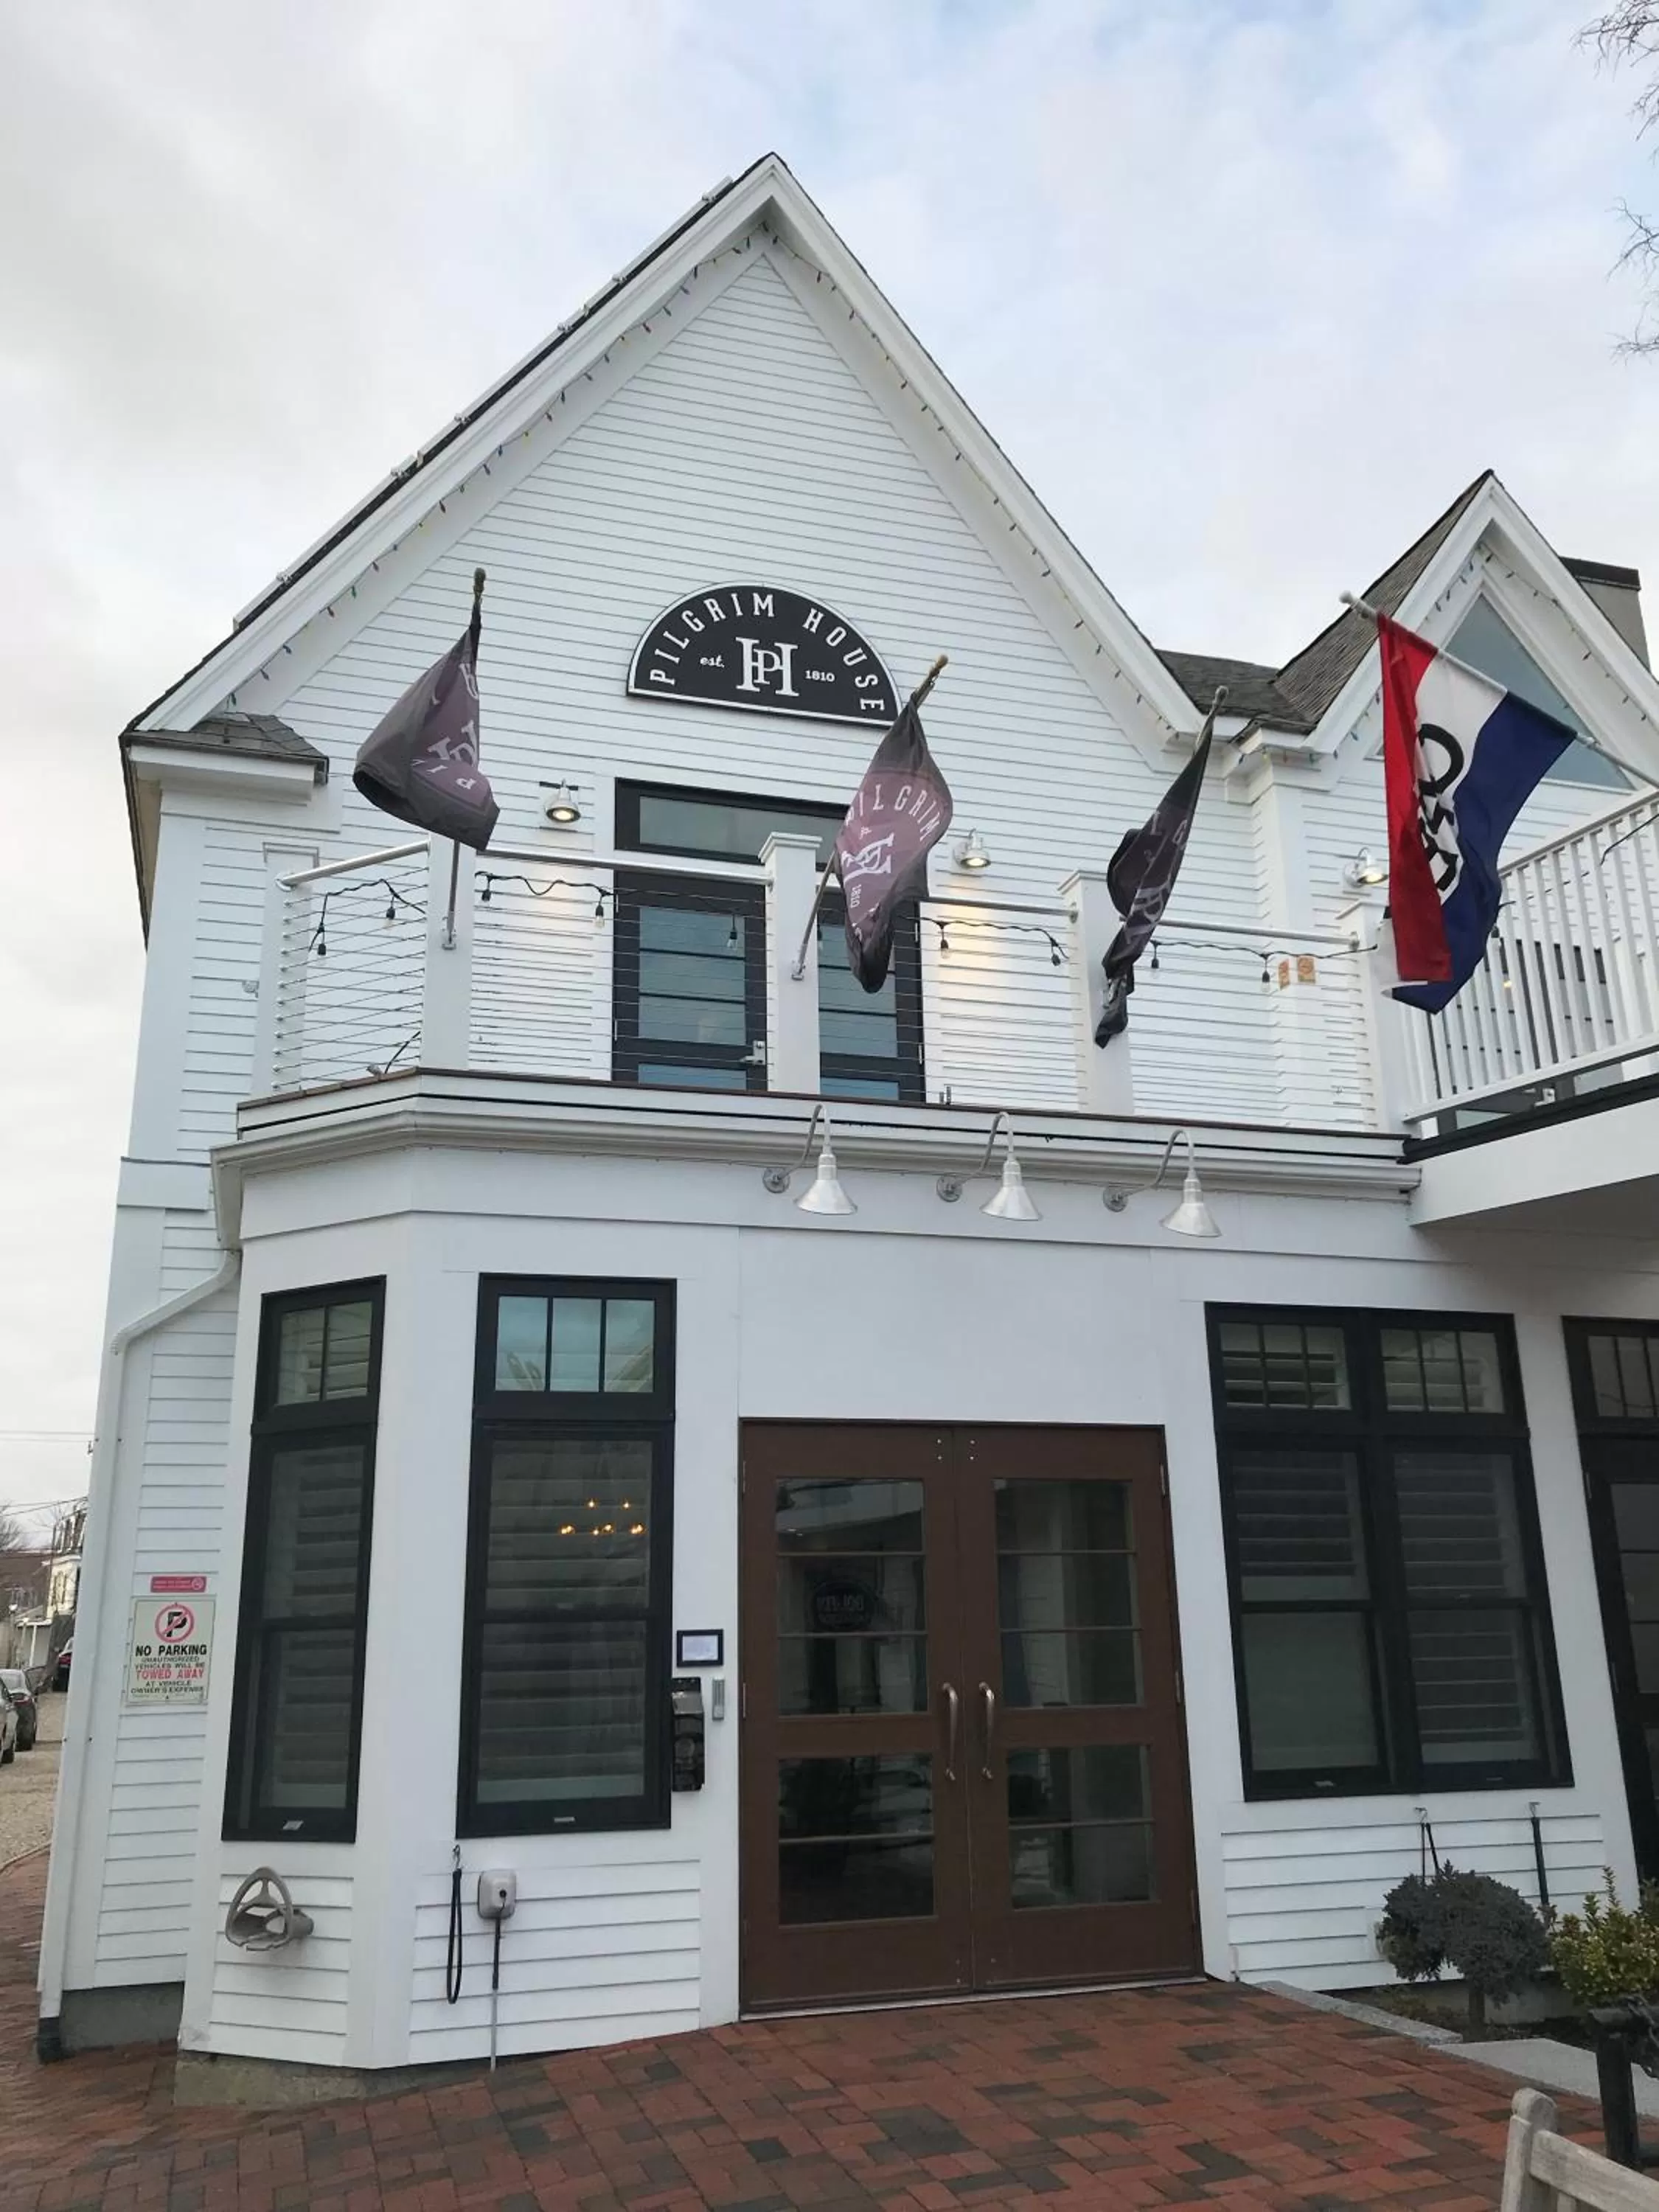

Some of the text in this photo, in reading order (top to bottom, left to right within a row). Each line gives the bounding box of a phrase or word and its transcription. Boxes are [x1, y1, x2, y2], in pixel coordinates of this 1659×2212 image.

[650, 593, 884, 711] PILGRIM HOUSE
[700, 655, 725, 668] est.
[804, 669, 835, 683] 1810
[845, 784, 941, 842] PILGRIM
[135, 1645, 207, 1657] NO PARKING
[136, 1669, 205, 1681] TOWED AWAY
